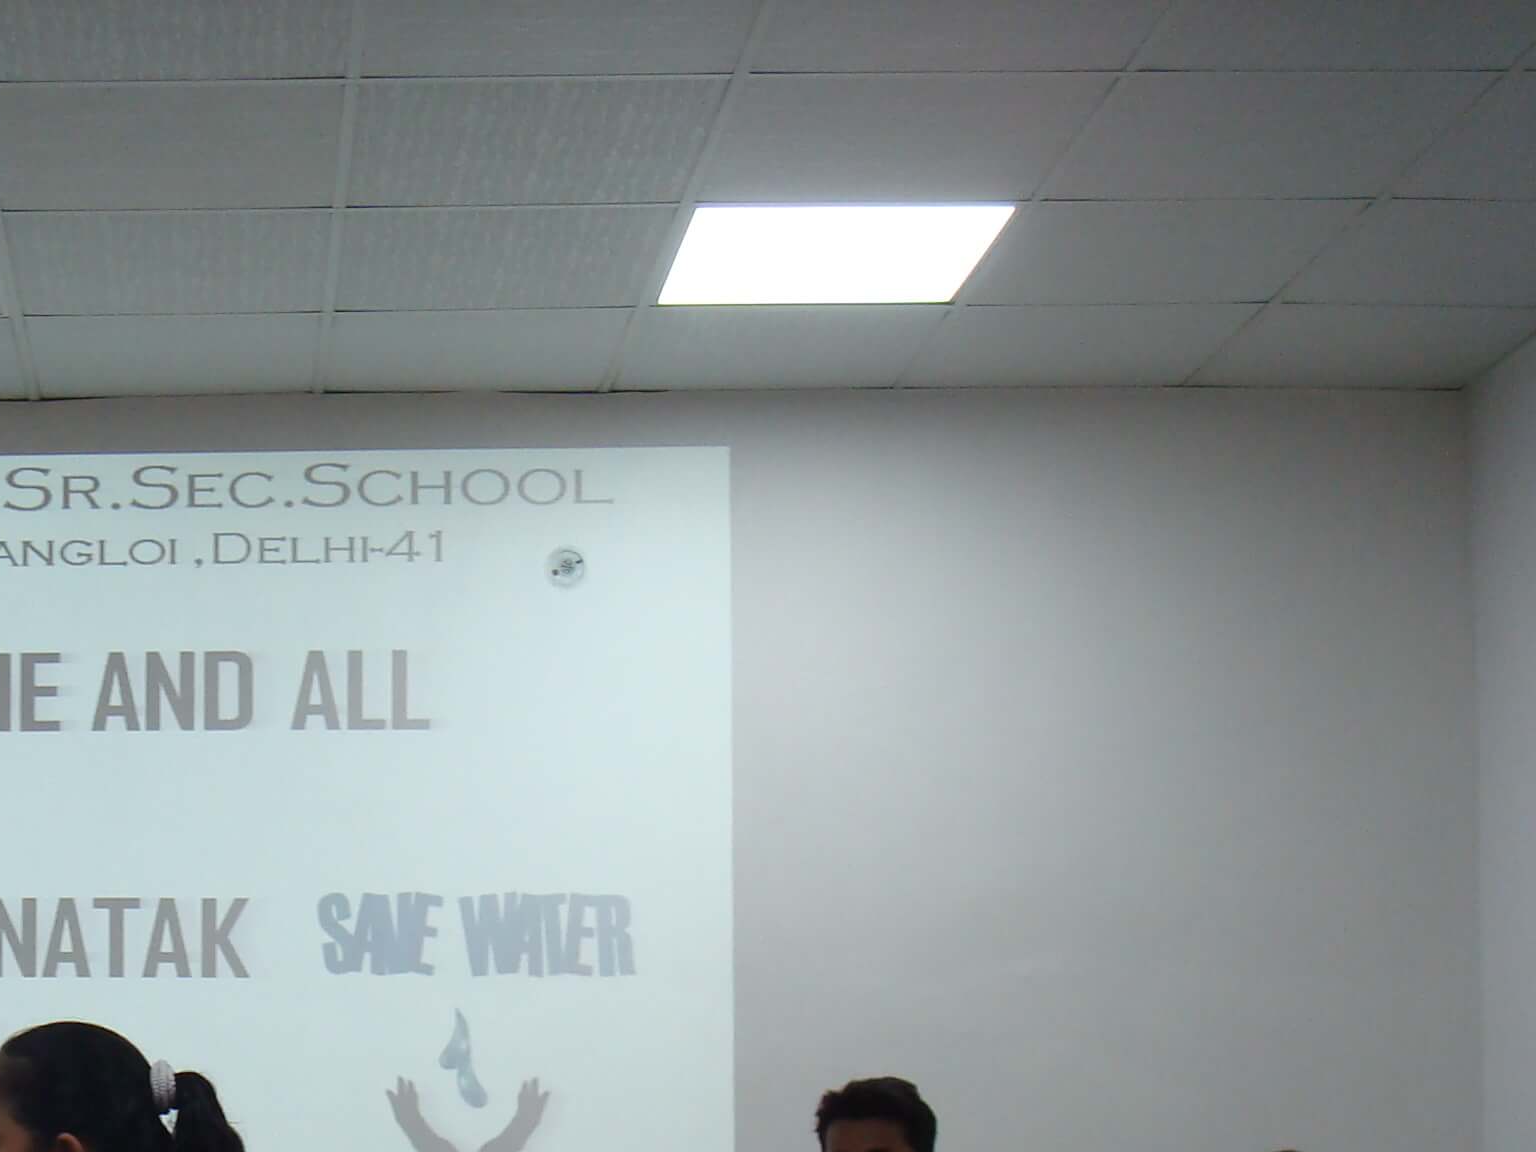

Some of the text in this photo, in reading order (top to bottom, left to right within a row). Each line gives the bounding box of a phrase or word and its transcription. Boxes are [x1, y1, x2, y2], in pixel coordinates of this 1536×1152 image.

[92, 652, 254, 733] AND
[292, 649, 431, 731] ALL
[317, 892, 637, 978] SAVE WATER
